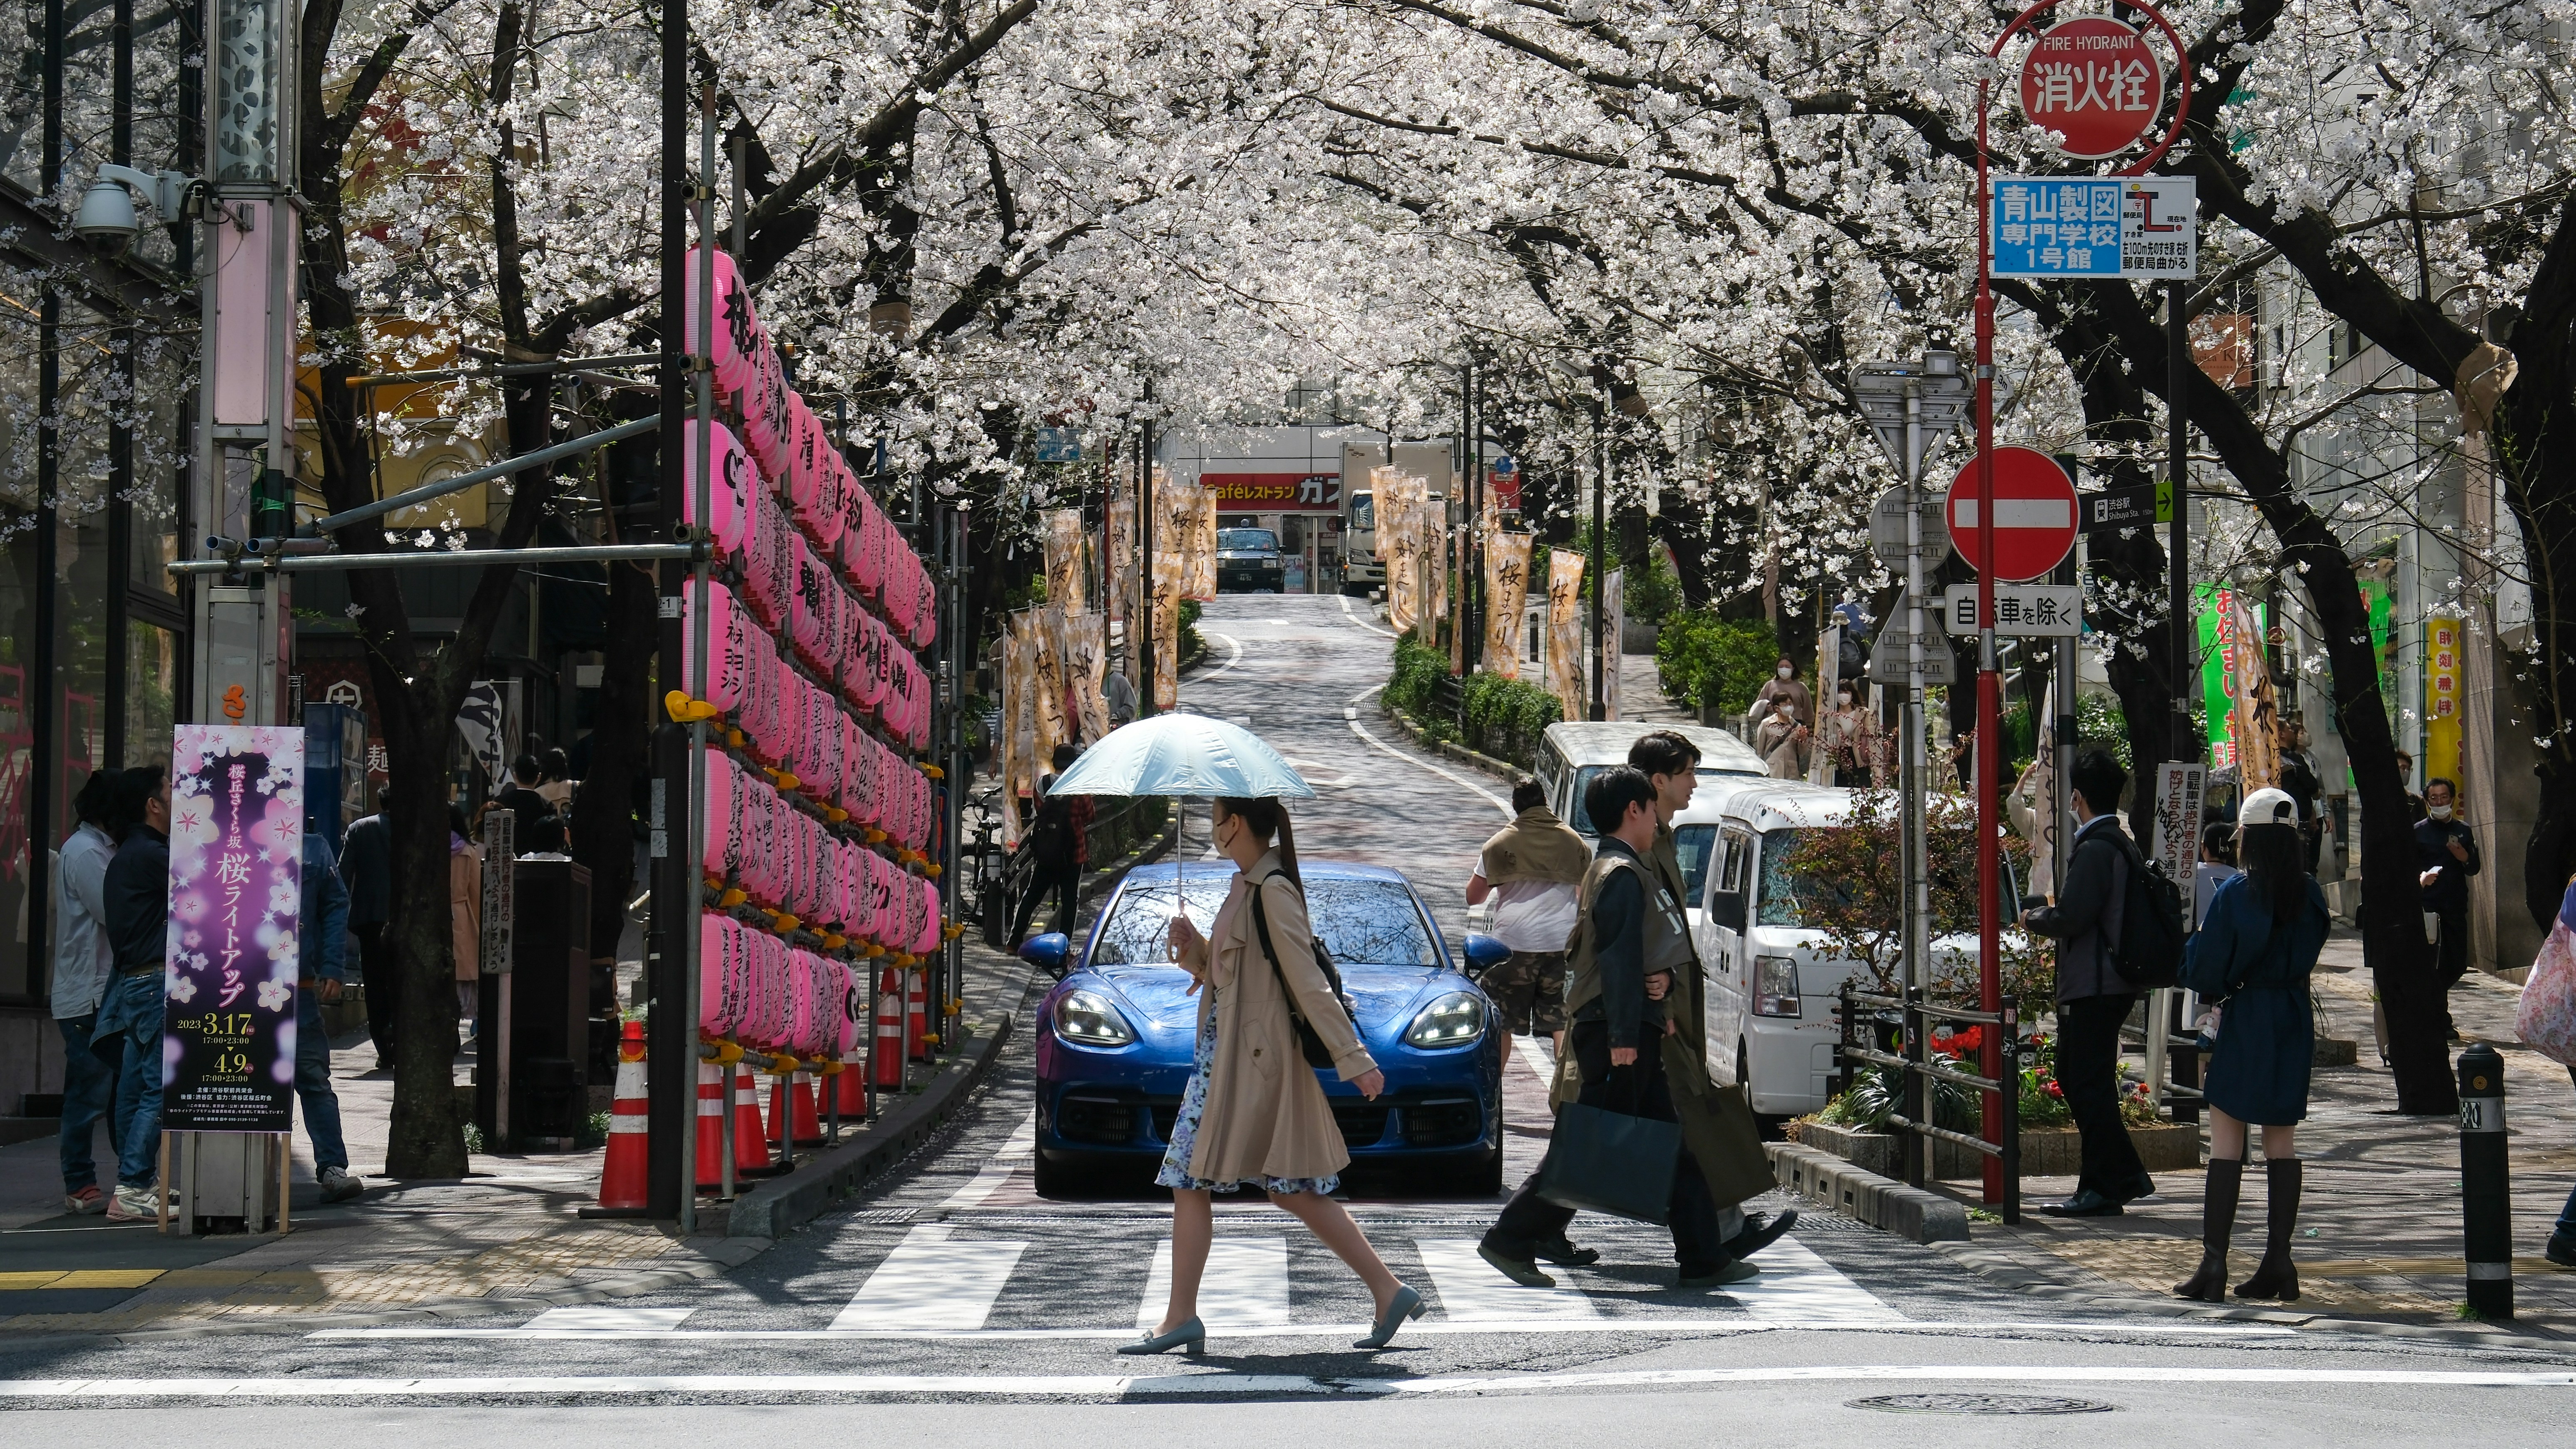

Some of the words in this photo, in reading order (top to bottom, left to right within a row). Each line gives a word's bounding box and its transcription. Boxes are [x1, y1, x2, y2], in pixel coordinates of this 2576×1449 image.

[2043, 36, 2071, 51] FIRE
[2077, 35, 2135, 50] HYDRANT
[2033, 59, 2150, 113] 消火栓
[2001, 184, 2119, 222] 青山製図
[2001, 224, 2118, 246] 専門学校
[2026, 248, 2092, 270] 1号館
[2123, 242, 2175, 256] 左100m先のすき家
[2177, 242, 2188, 256] 右折
[2123, 256, 2188, 270] 郵便局曲がる
[2109, 497, 2130, 510] 渋谷駅
[2109, 511, 2129, 520] Shibuya
[1171, 507, 1191, 553] 桜ま
[1498, 560, 1522, 648] 桜まつり
[1957, 597, 2071, 626] 自車を除く
[1166, 610, 1176, 654] 渋谷桜丘
[227, 764, 246, 849] 桜丘さくら坂
[2180, 771, 2201, 879] 自転車は歩行者の通行の
[214, 852, 251, 1008] 桜ライトアップ
[177, 1019, 201, 1028] 2023
[203, 1013, 251, 1035] 3.17
[214, 1054, 246, 1073] 4.9
